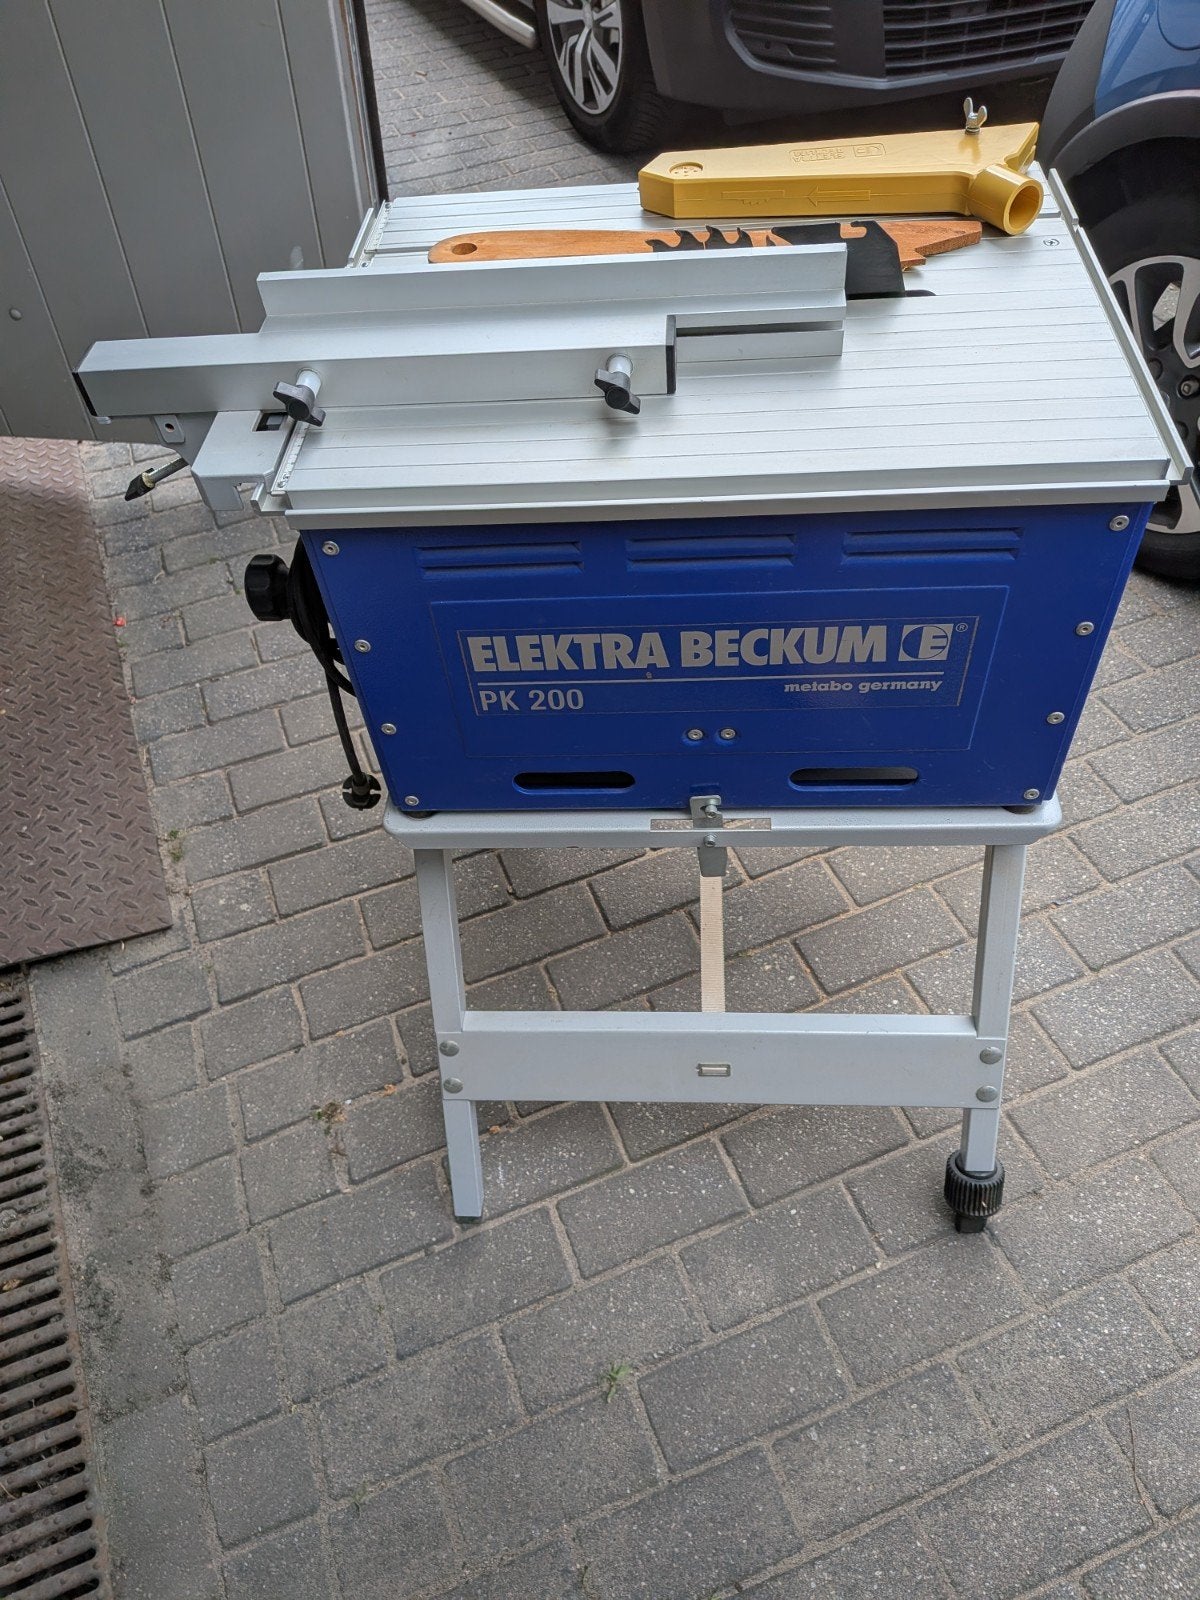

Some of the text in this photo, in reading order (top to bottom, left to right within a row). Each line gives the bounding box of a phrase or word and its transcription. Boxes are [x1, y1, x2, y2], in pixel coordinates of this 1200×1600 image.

[467, 632, 670, 672] ELEKTRA
[680, 625, 887, 667] BECKUM
[784, 680, 943, 694] metabo germany
[479, 688, 585, 711] PK 200
